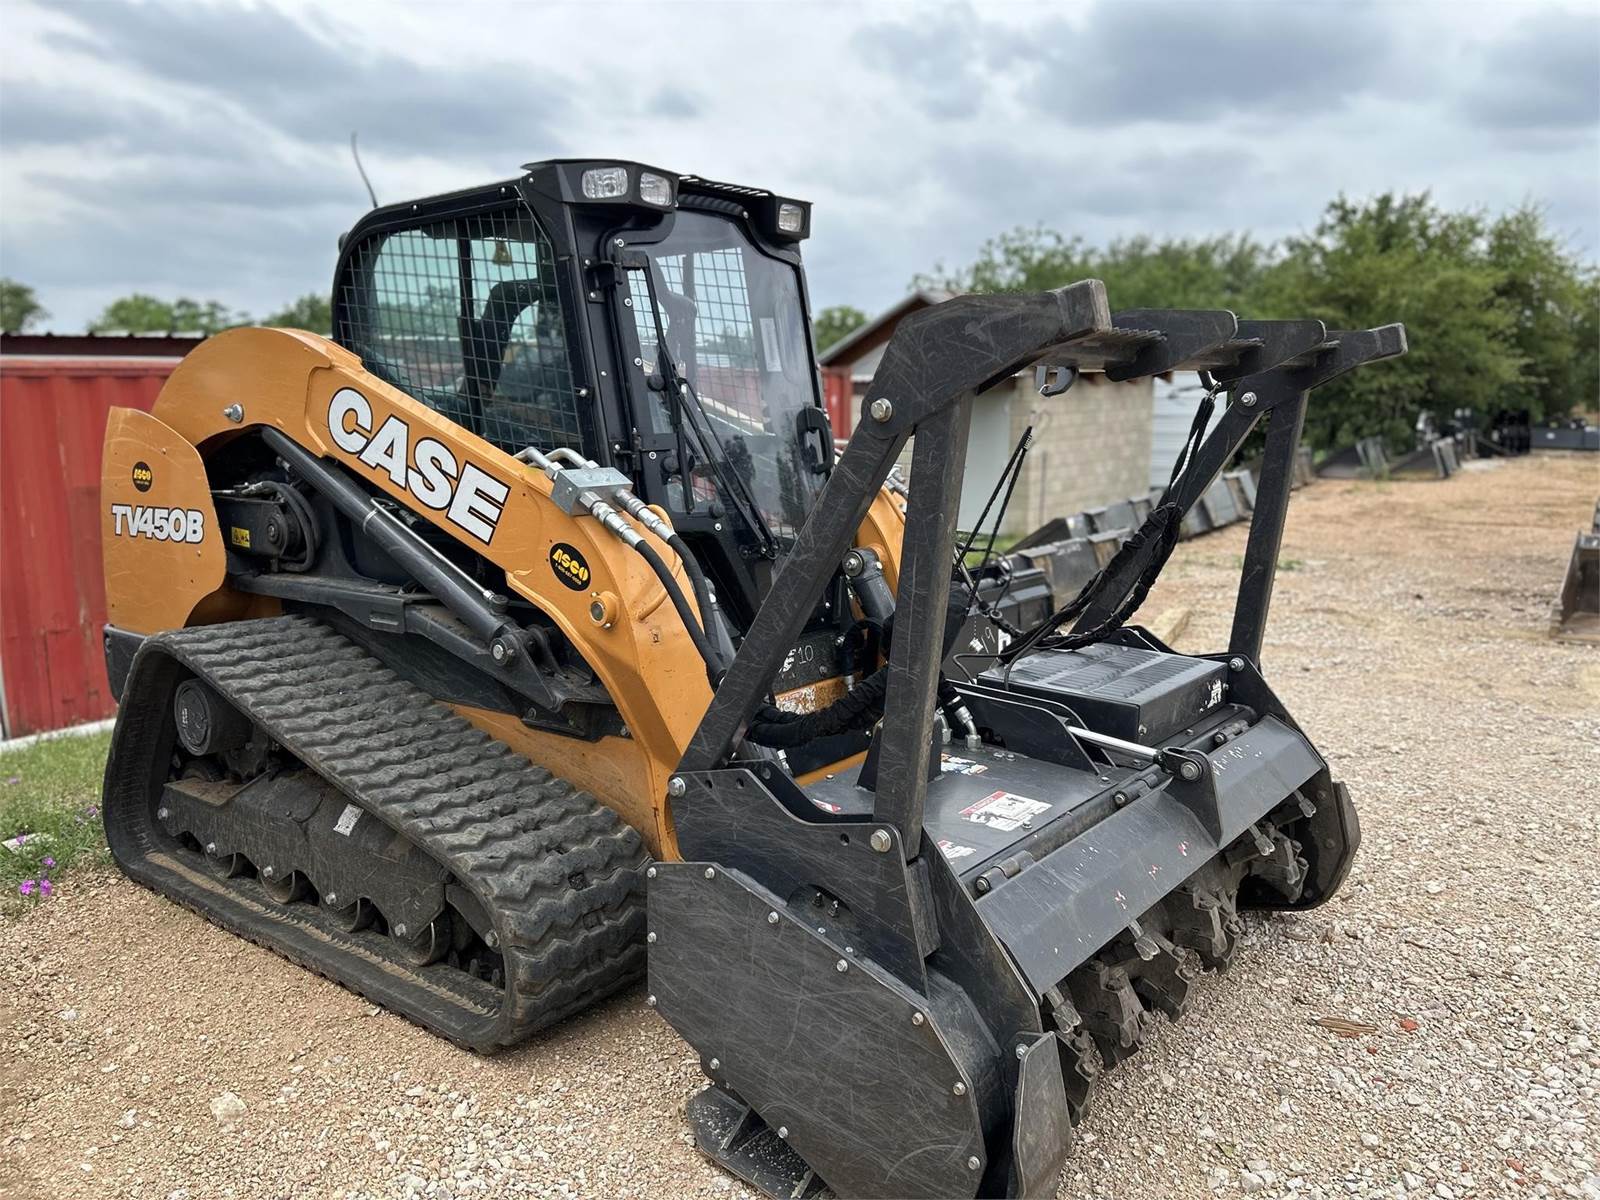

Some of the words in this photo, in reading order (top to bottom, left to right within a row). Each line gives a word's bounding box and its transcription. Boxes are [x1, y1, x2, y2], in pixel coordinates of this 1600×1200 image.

[328, 387, 511, 545] CASE
[112, 504, 204, 544] TV450B
[552, 548, 589, 581] ASCO
